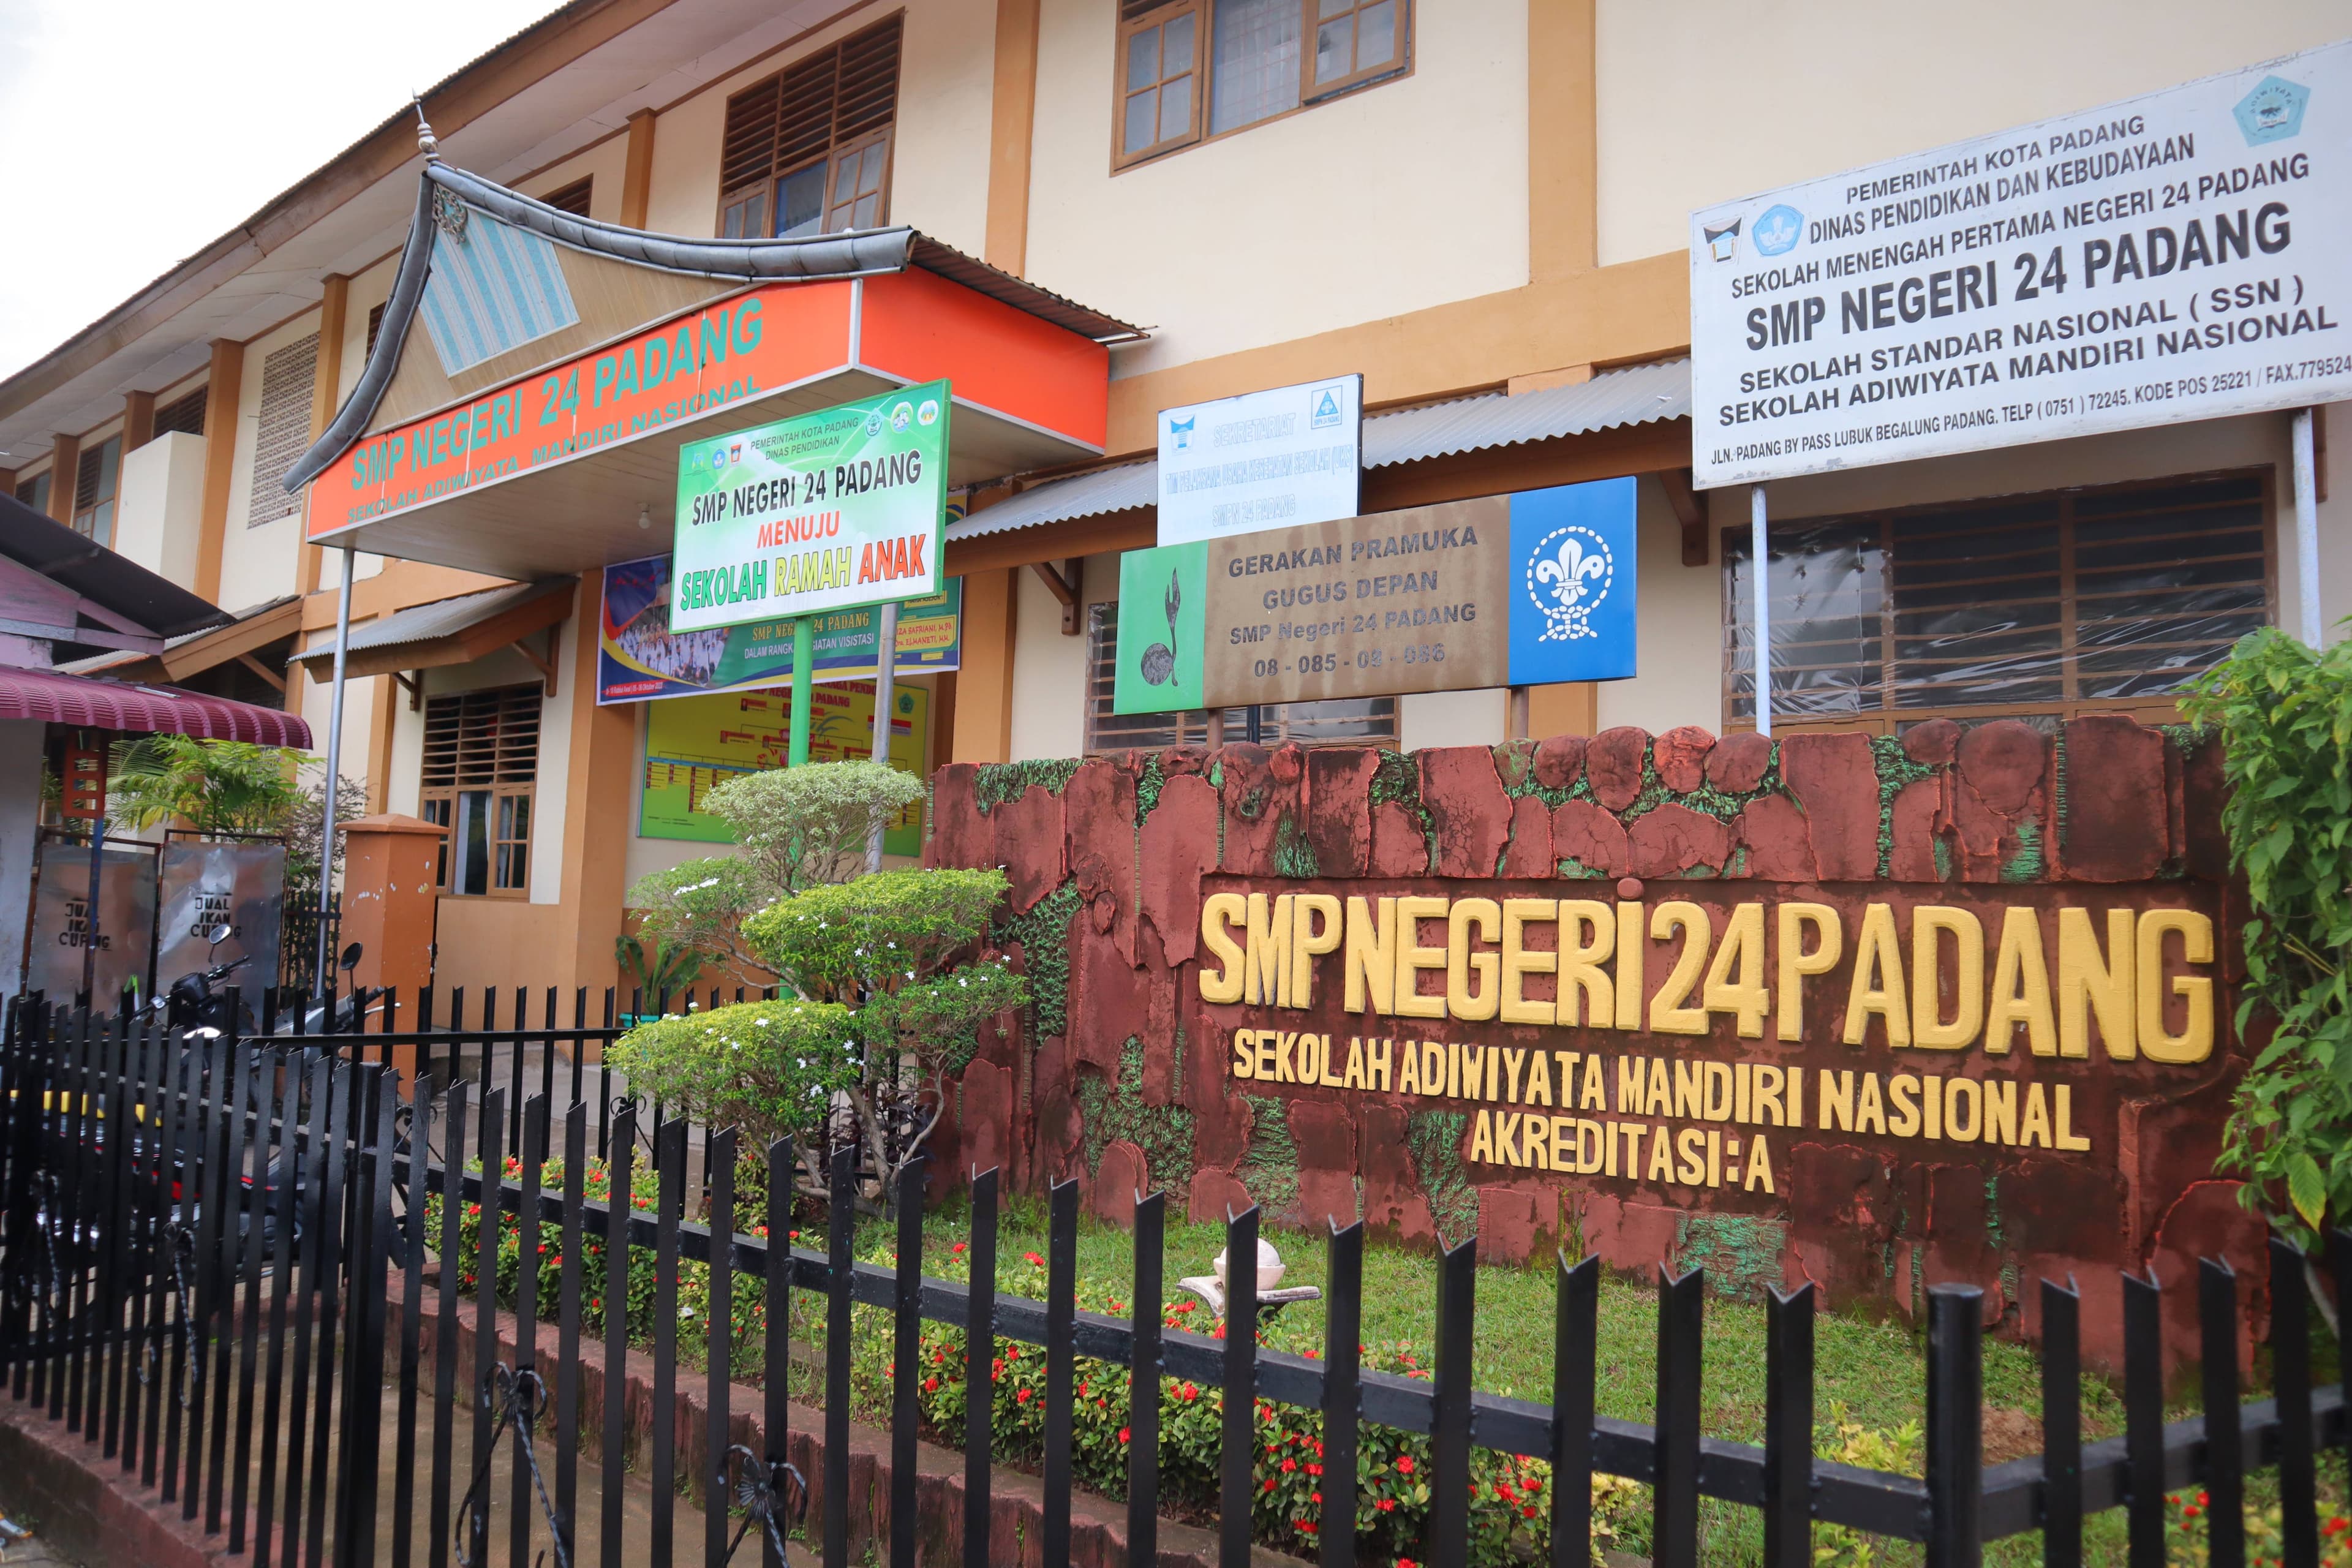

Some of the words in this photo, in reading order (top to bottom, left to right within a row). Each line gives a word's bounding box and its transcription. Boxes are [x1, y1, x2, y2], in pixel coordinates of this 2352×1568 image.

[1847, 157, 1978, 204] PEMERINTAH
[1985, 141, 2043, 172] KOTA
[2050, 115, 2144, 155] PADANG
[1811, 210, 1866, 244] DINAS
[1872, 181, 1991, 231] PENDIDIKAN
[1997, 170, 2040, 202] DAN
[2047, 132, 2195, 190] KEBUDAYAAN
[1732, 261, 1819, 299] SEKOLAH
[1826, 235, 1944, 279] MENENGAH
[1952, 209, 2056, 252] PERTAMA
[2064, 188, 2154, 229] NEGERI
[2162, 181, 2191, 209] 24
[2199, 153, 2310, 200] PADANG
[1746, 296, 1826, 351] SMP
[1842, 260, 1998, 334] NEGERI
[2014, 245, 2068, 301] 24
[2084, 202, 2292, 289] PADANG
[1719, 387, 1839, 427] SEKOLAH
[1849, 361, 2000, 407] ADIWIYATA
[2010, 336, 2144, 380] MANDIRI
[2157, 305, 2338, 357] NASIONAL
[1740, 353, 1861, 393] SEKOLAH
[1871, 328, 2003, 371] STANDAR
[2014, 298, 2177, 347] NASIONAL
[352, 432, 404, 489] SMP
[411, 388, 522, 473] NEGERI
[539, 367, 579, 427] 24
[594, 298, 763, 409] PADANG
[1711, 448, 1734, 466] JLN.
[1737, 439, 1781, 462] PADANG
[1785, 437, 1800, 454] BY
[1802, 432, 1831, 452] PASS
[1835, 426, 1873, 448] LUBUK
[1876, 416, 1940, 441] BEGALUNG
[1943, 407, 1999, 431] PADANG.
[2002, 403, 2034, 423] TELP
[2089, 388, 2132, 410] 72245.
[2135, 380, 2174, 404] KODE
[2179, 376, 2208, 397] POS
[2212, 371, 2252, 393] 25221
[347, 488, 418, 523] SEKOLAH
[423, 455, 519, 500] ADIWIYATA
[531, 420, 622, 464] MANDIRI
[631, 374, 761, 432] NASIONAL
[750, 432, 799, 451] PEMERINTAH
[801, 426, 823, 440] KOTA
[824, 417, 859, 434] PADANG
[766, 447, 789, 461] DINAS
[791, 435, 840, 455] PENDIDIKAN
[1213, 412, 1296, 447] SEKRETARIAT
[692, 491, 727, 526] SMP
[733, 476, 795, 519] NEGERI
[804, 469, 826, 505] 24
[835, 449, 921, 498] PADANG
[1166, 471, 1178, 495] TIM
[1180, 465, 1221, 494] PELAKSANA
[1222, 459, 1248, 490] USAHA
[1249, 453, 1294, 487] KESEHATAN
[1294, 446, 1330, 475] SEKOLAH
[757, 510, 840, 549] MENUJU
[1212, 499, 1240, 527] SMPN
[1242, 500, 1254, 523] 24
[1256, 494, 1296, 519] PADANG
[680, 560, 767, 611] SEKOLAH
[774, 546, 852, 597] RAMAH
[858, 533, 926, 584] ANAK
[1228, 544, 1342, 579] GERAKAN
[1351, 526, 1479, 562] PRAMUKA
[1263, 579, 1348, 611] GUGUS
[1357, 570, 1438, 600] DEPAN
[744, 647, 766, 659] DALAM
[768, 643, 794, 655] RANGK
[839, 633, 875, 647] VISISTASI
[752, 626, 772, 641] SMP
[827, 612, 870, 631] PADANG
[1229, 625, 1272, 645] SMP
[1278, 615, 1346, 642] Negeri
[1352, 613, 1378, 634] 24
[1385, 602, 1477, 628] PADANG
[1254, 658, 1278, 677] 08
[1298, 654, 1337, 674] 085
[195, 897, 230, 910] JUAL
[200, 912, 231, 924] IKAN
[1199, 892, 1343, 1009] SMP
[1344, 896, 1645, 1031] NEGERI
[1649, 900, 1770, 1039] 24
[1777, 902, 2215, 1065] PADANG
[1234, 1028, 1393, 1092] SEKOLAH
[1400, 1040, 1607, 1112] ADIWIYATA
[1618, 1055, 1803, 1128] MANDIRI
[1819, 1068, 2091, 1152] NASIONAL
